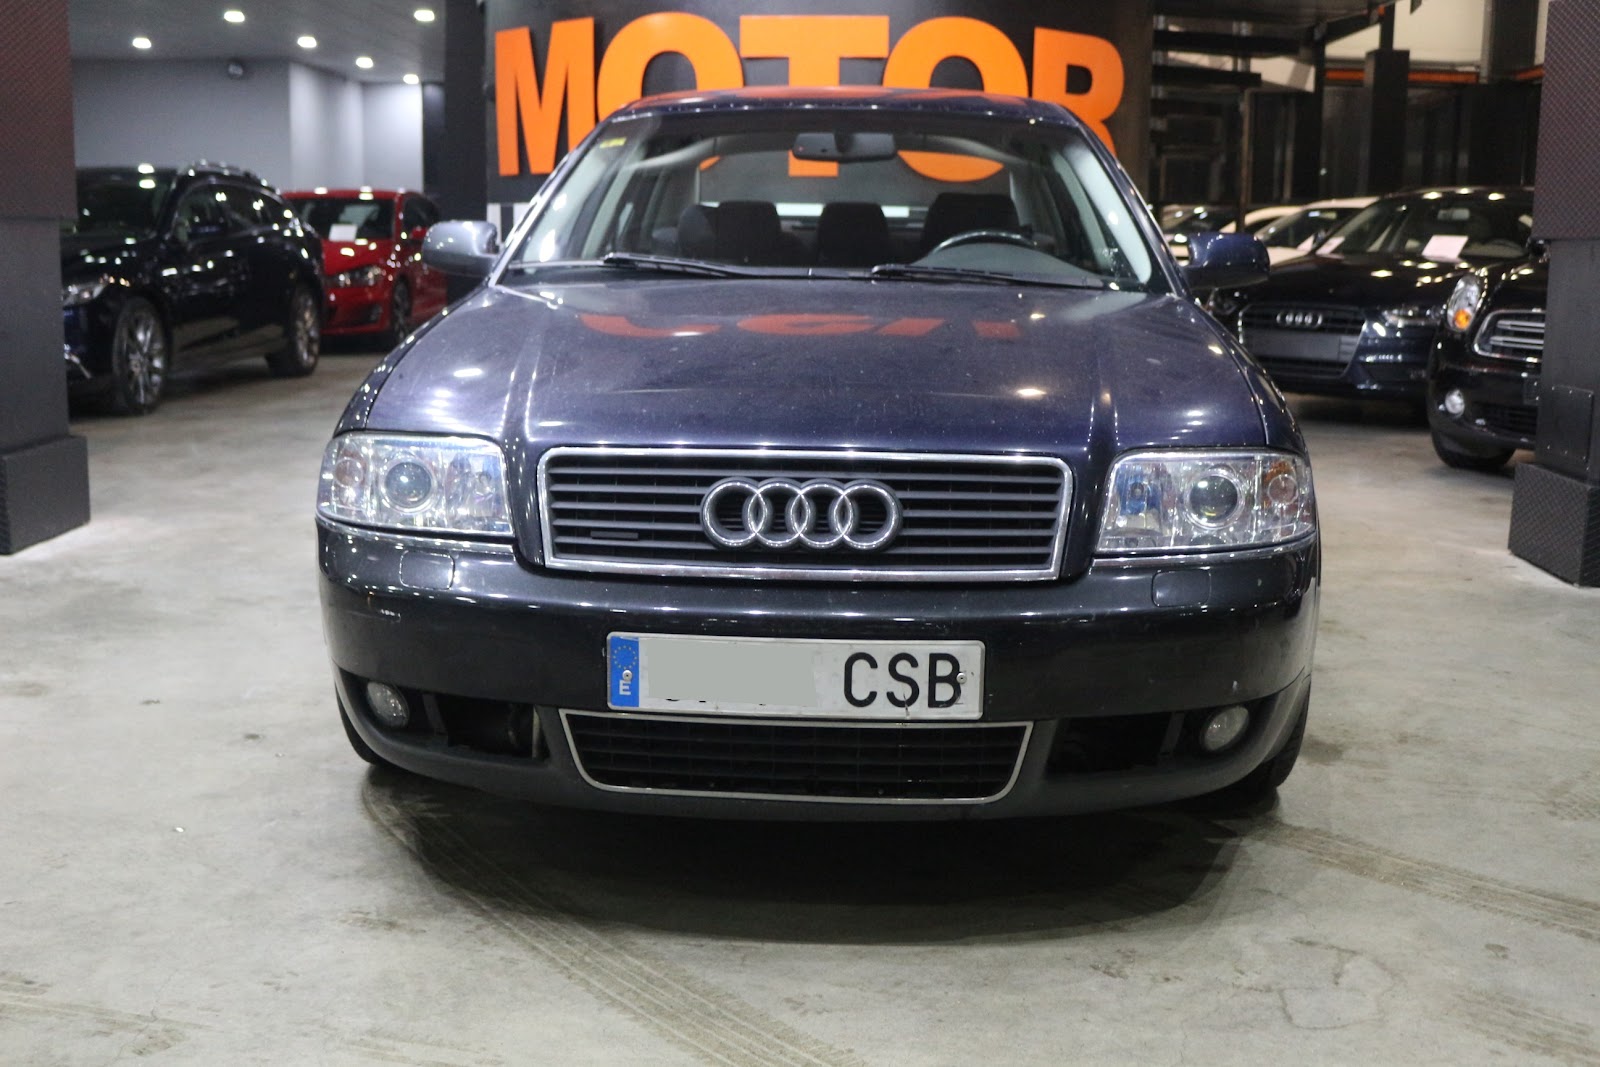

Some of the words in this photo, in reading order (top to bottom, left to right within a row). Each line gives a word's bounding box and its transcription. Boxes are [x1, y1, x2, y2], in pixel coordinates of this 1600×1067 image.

[495, 12, 1125, 182] MOTOR
[619, 680, 631, 695] E
[844, 652, 962, 708] CSB
